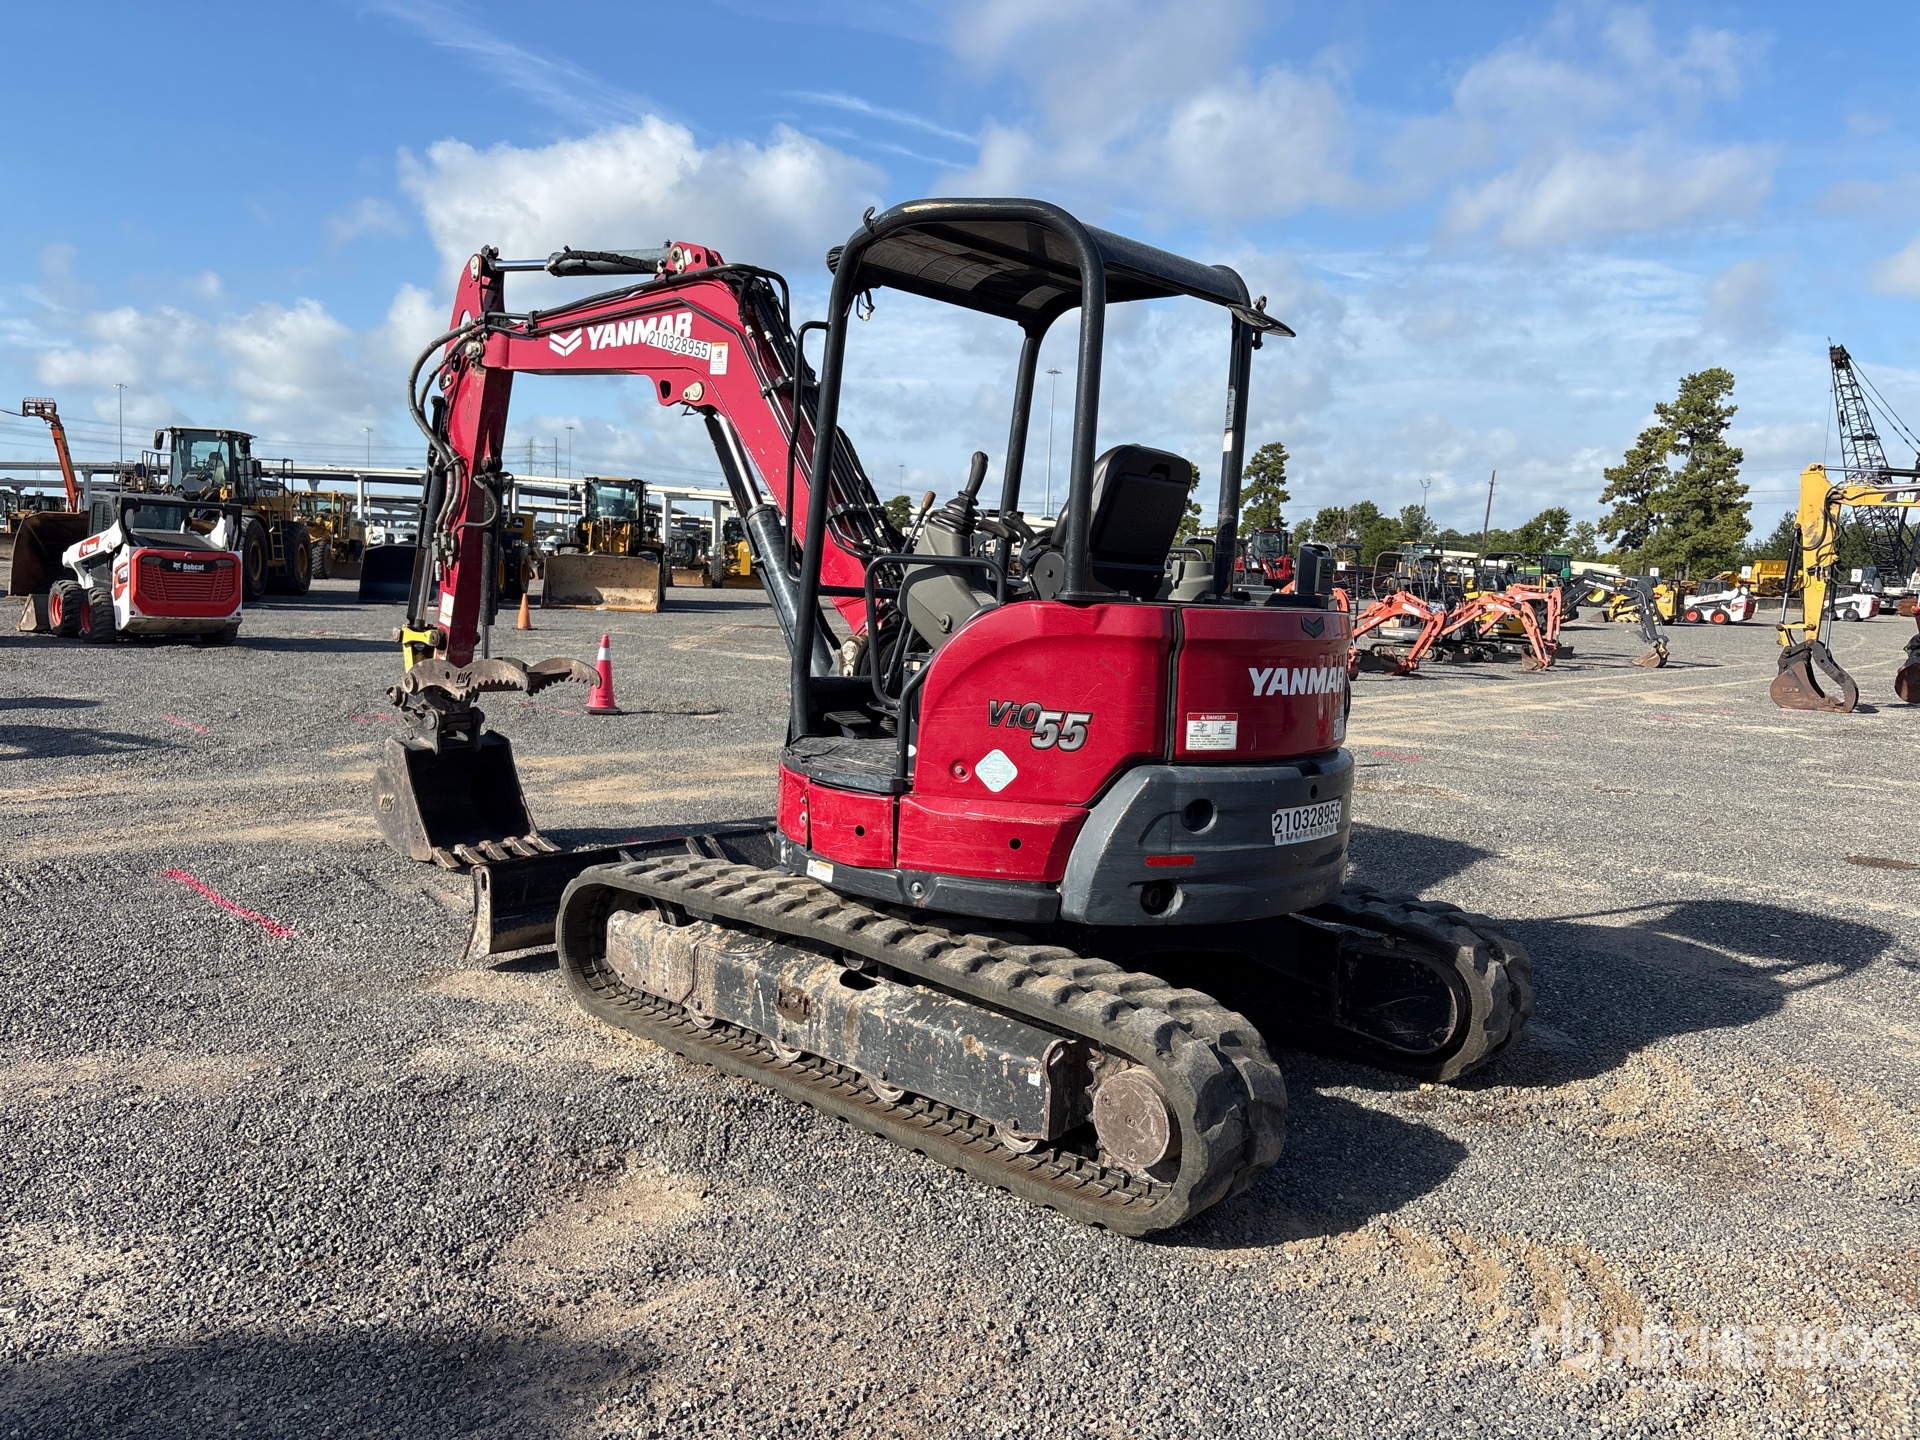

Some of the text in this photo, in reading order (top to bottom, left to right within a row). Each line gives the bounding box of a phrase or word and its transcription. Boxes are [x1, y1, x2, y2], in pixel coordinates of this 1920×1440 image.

[587, 312, 693, 350] YANMAR
[648, 330, 708, 358] 210328955
[1896, 491, 1917, 502] CAT
[183, 563, 204, 571] Bobcat
[1248, 667, 1344, 697] YANMAR
[1273, 802, 1340, 834] 210328955
